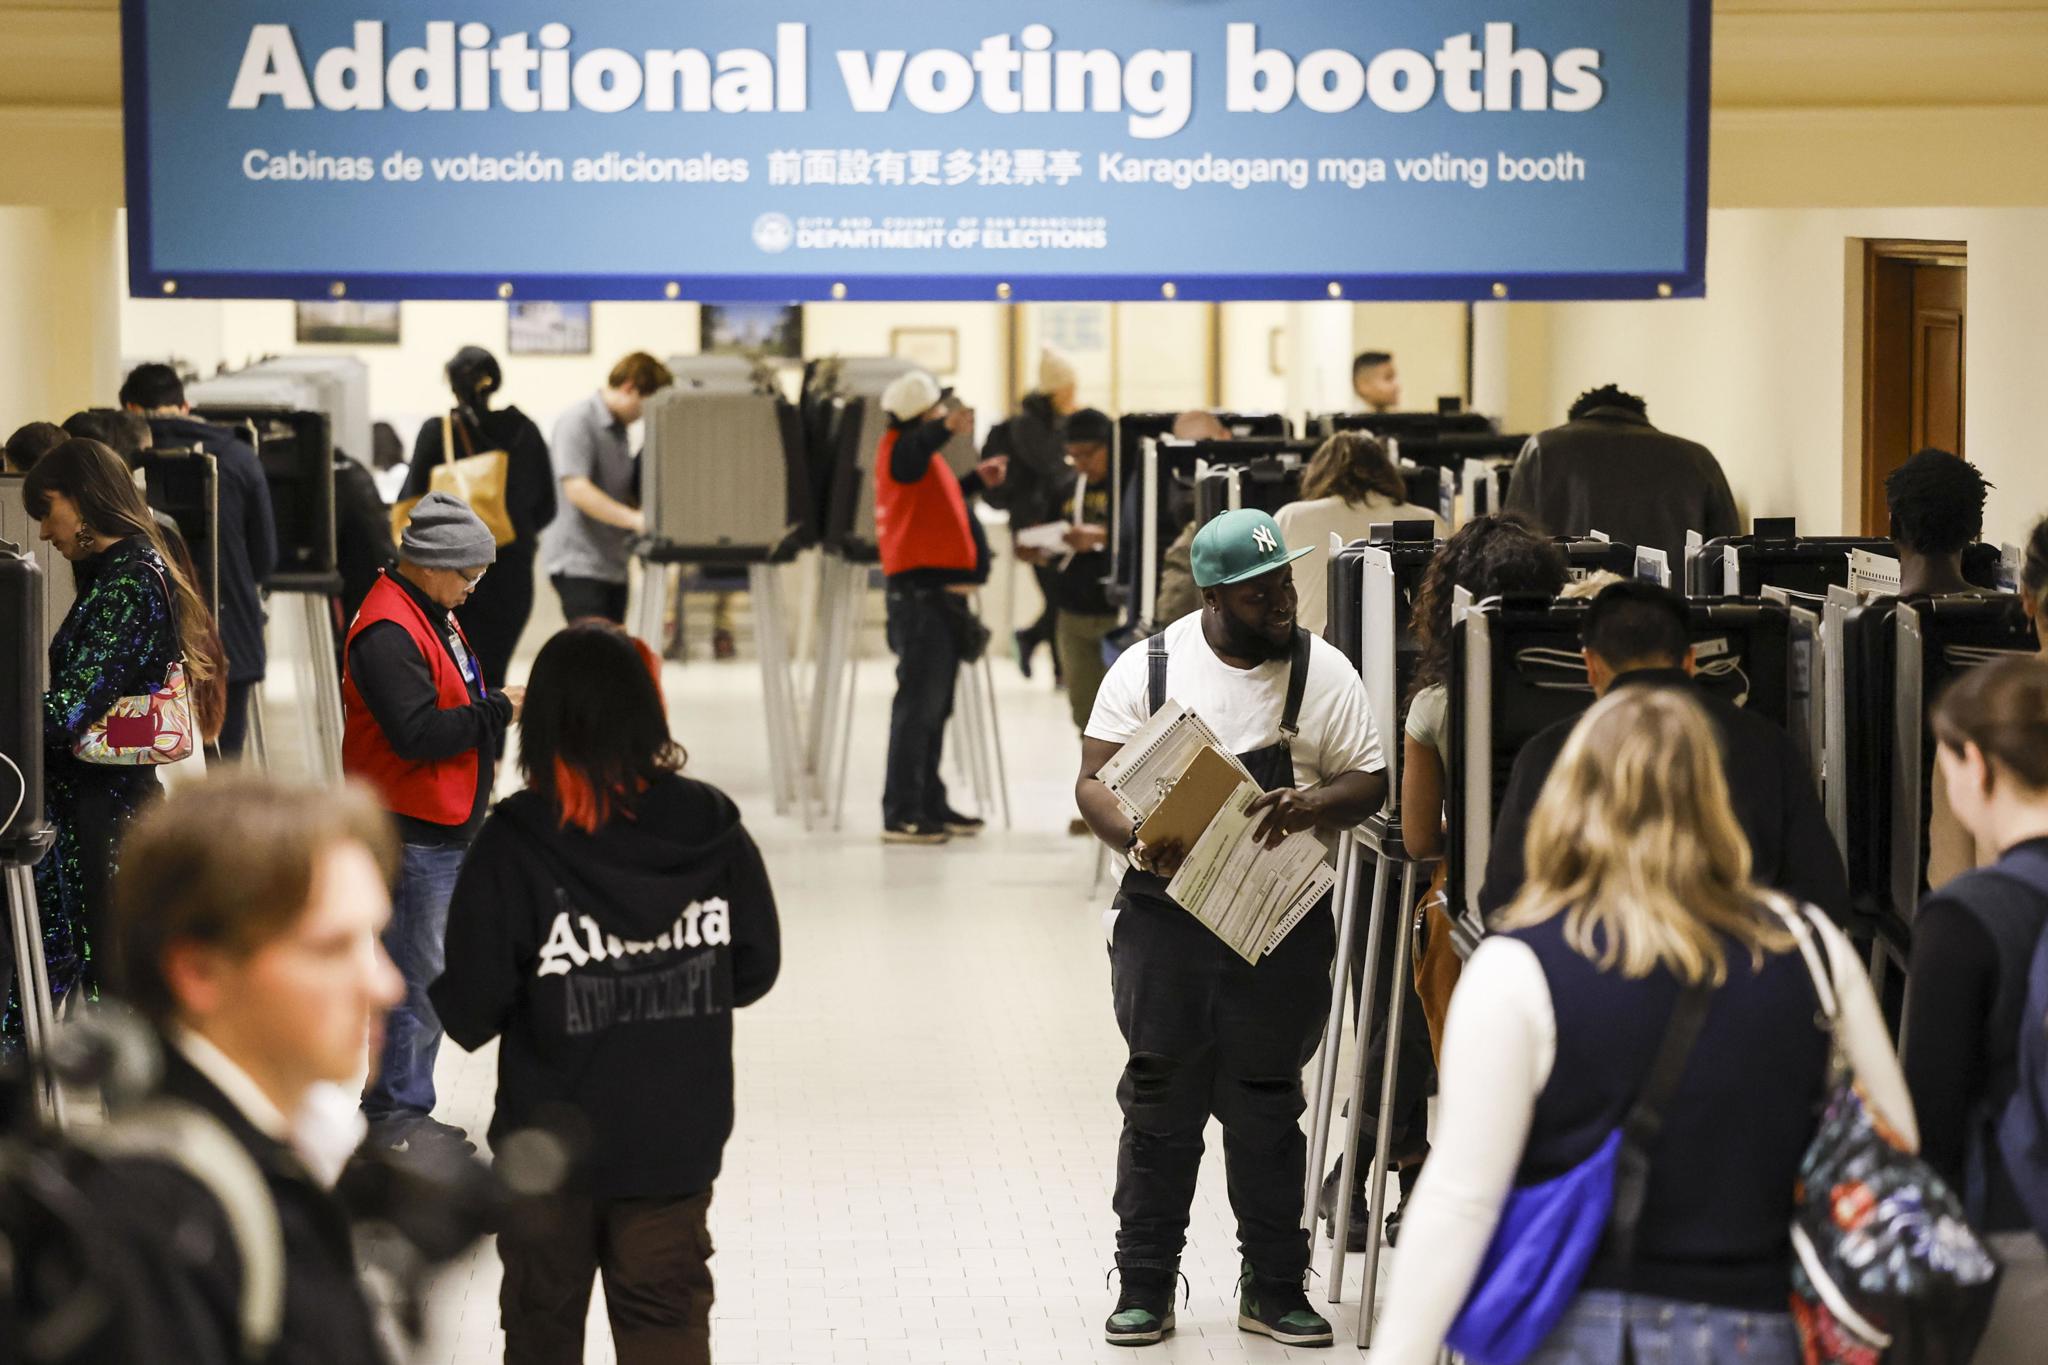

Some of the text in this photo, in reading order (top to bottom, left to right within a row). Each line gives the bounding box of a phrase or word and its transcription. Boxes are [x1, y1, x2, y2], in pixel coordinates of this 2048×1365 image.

[229, 21, 1603, 139] Additional voting booths
[243, 149, 749, 182] Cabinas de votación adicionales
[768, 149, 1082, 186] 前面設有更多投票亭
[1099, 151, 1585, 190] Karagdagang mga voting booth
[797, 228, 1108, 249] DEPARTMENT OF ELECTIONS
